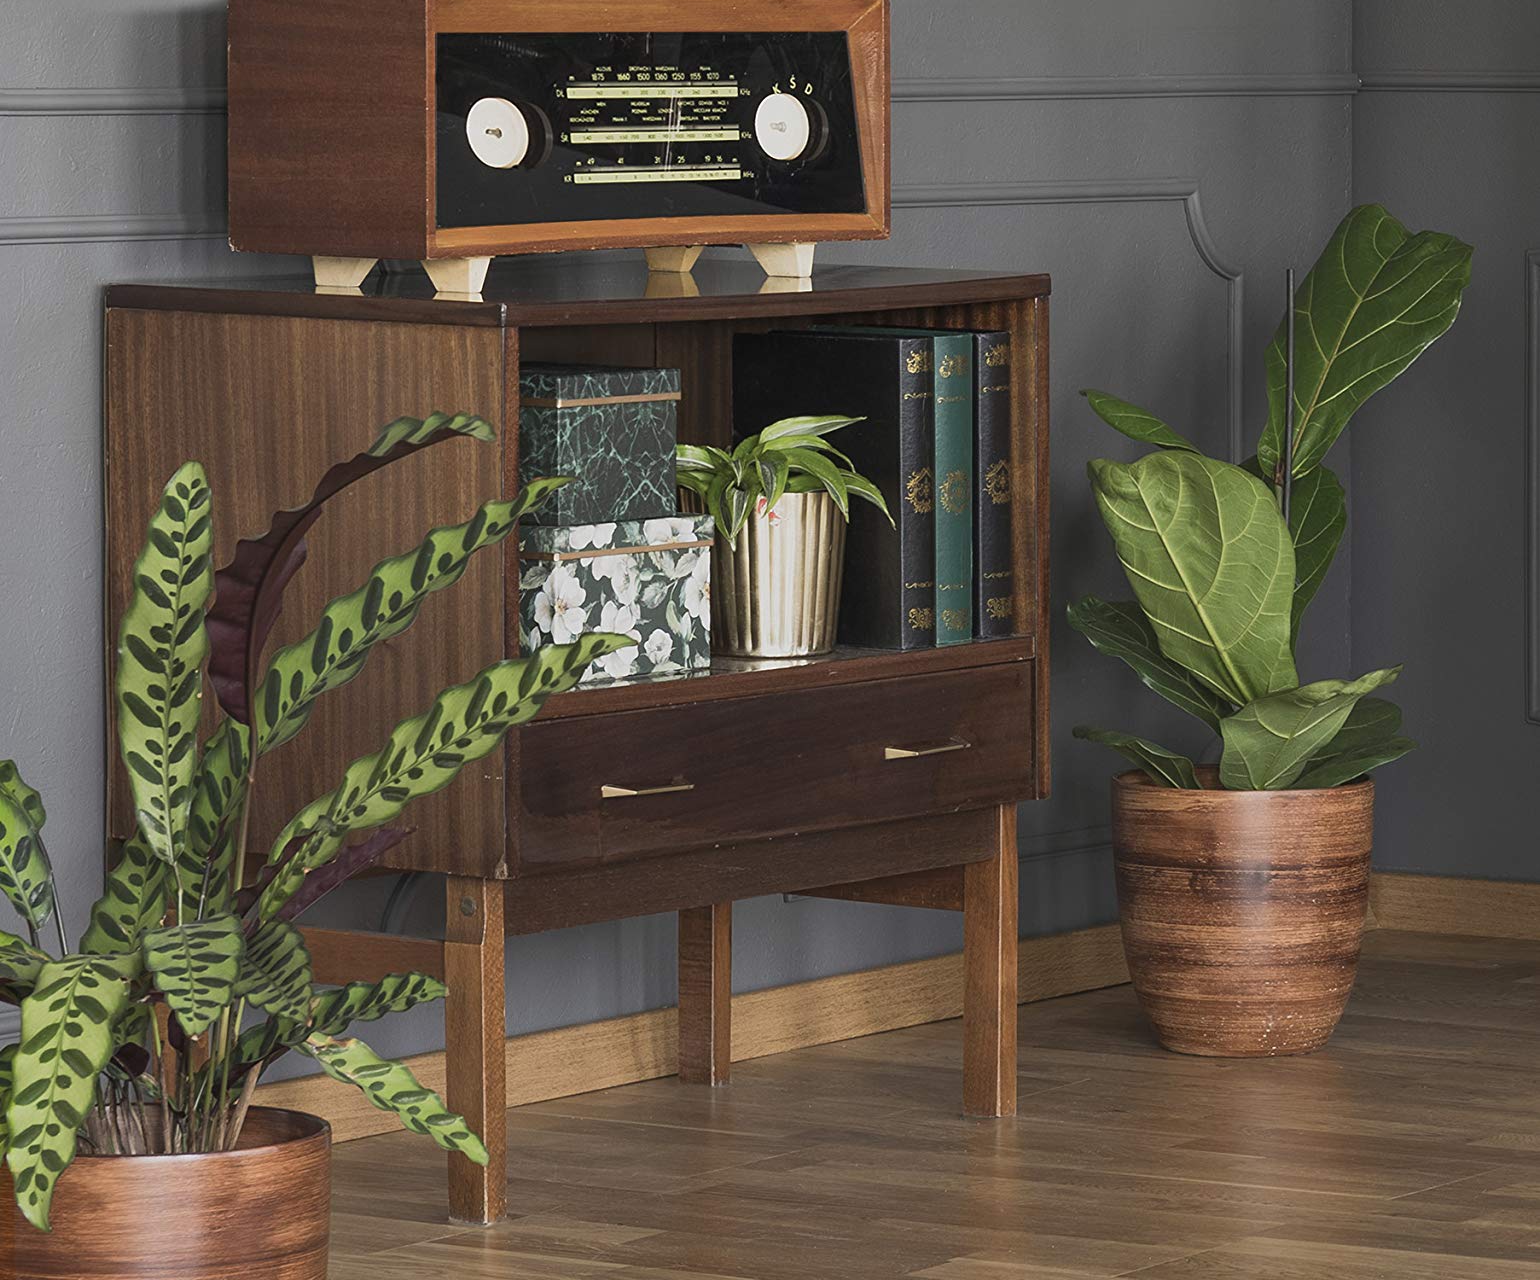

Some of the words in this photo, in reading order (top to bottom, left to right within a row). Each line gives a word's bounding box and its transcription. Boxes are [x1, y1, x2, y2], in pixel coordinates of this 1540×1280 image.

[591, 72, 605, 81] 1875
[616, 72, 631, 81] 1660
[636, 72, 651, 81] 1500
[654, 72, 668, 81] 1360
[671, 72, 686, 81] 1250
[772, 82, 782, 95] K
[804, 83, 813, 95] D
[587, 157, 595, 165] 49
[677, 155, 685, 164] 25
[704, 155, 711, 163] 19
[716, 155, 723, 163] 16
